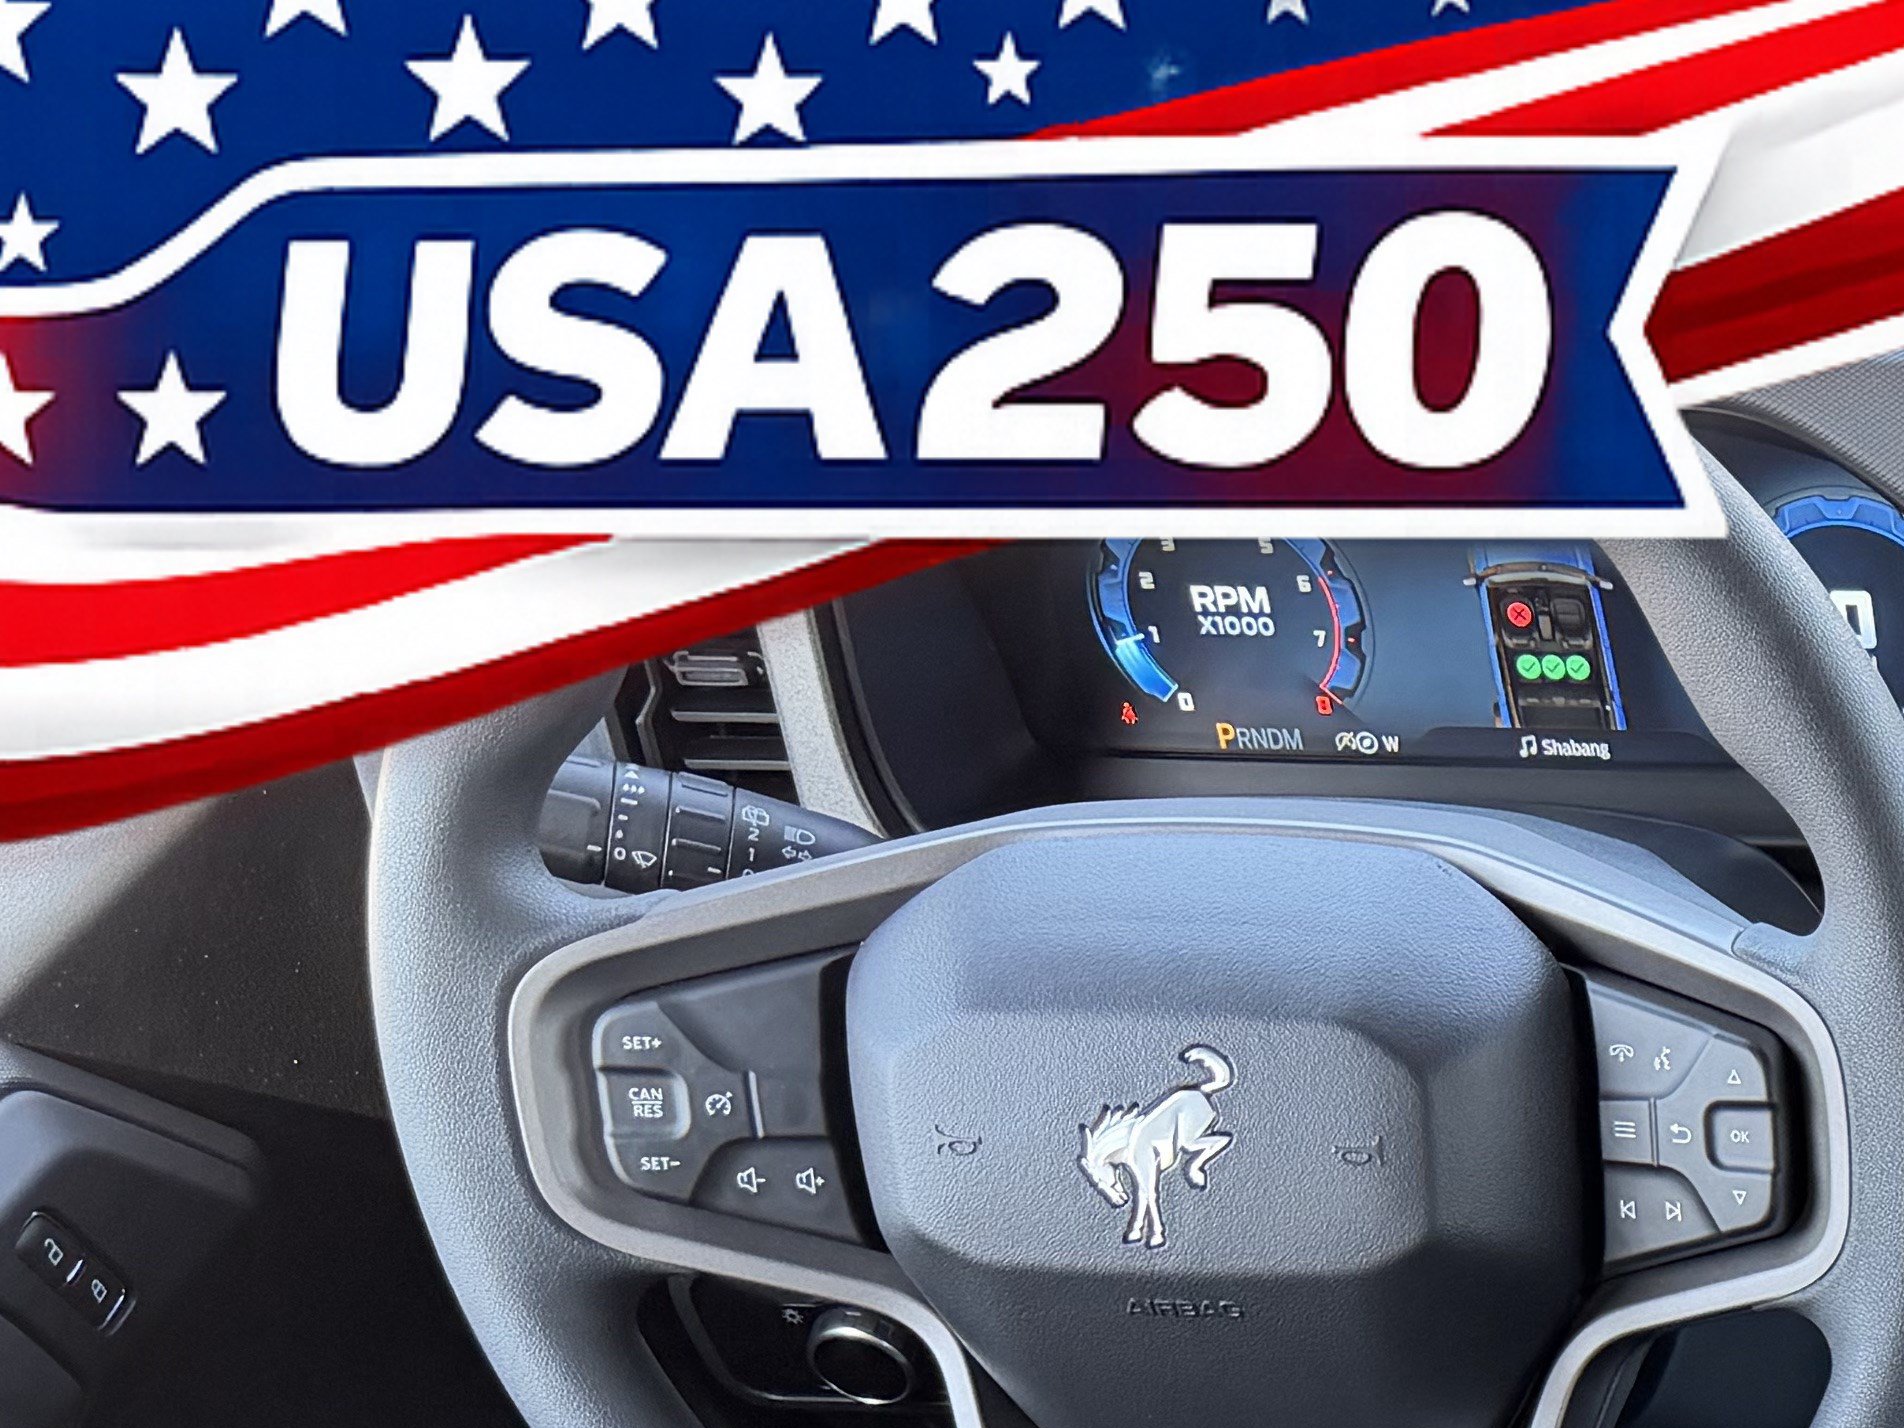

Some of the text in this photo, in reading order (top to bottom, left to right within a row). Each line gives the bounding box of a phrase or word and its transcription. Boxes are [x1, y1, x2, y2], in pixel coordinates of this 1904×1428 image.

[1139, 571, 1155, 590] 2
[1296, 575, 1311, 593] 6
[1189, 584, 1271, 614] RPM
[1148, 625, 1160, 643] 1
[1313, 630, 1325, 647] 7
[1177, 692, 1195, 711] 0
[1381, 735, 1399, 752] W
[1542, 738, 1611, 761] Shabang
[748, 828, 758, 841] 2
[629, 1088, 663, 1101] CAN
[633, 1105, 663, 1118] RES
[1730, 1130, 1749, 1143] OK
[1127, 1298, 1245, 1319] AIRBAG
